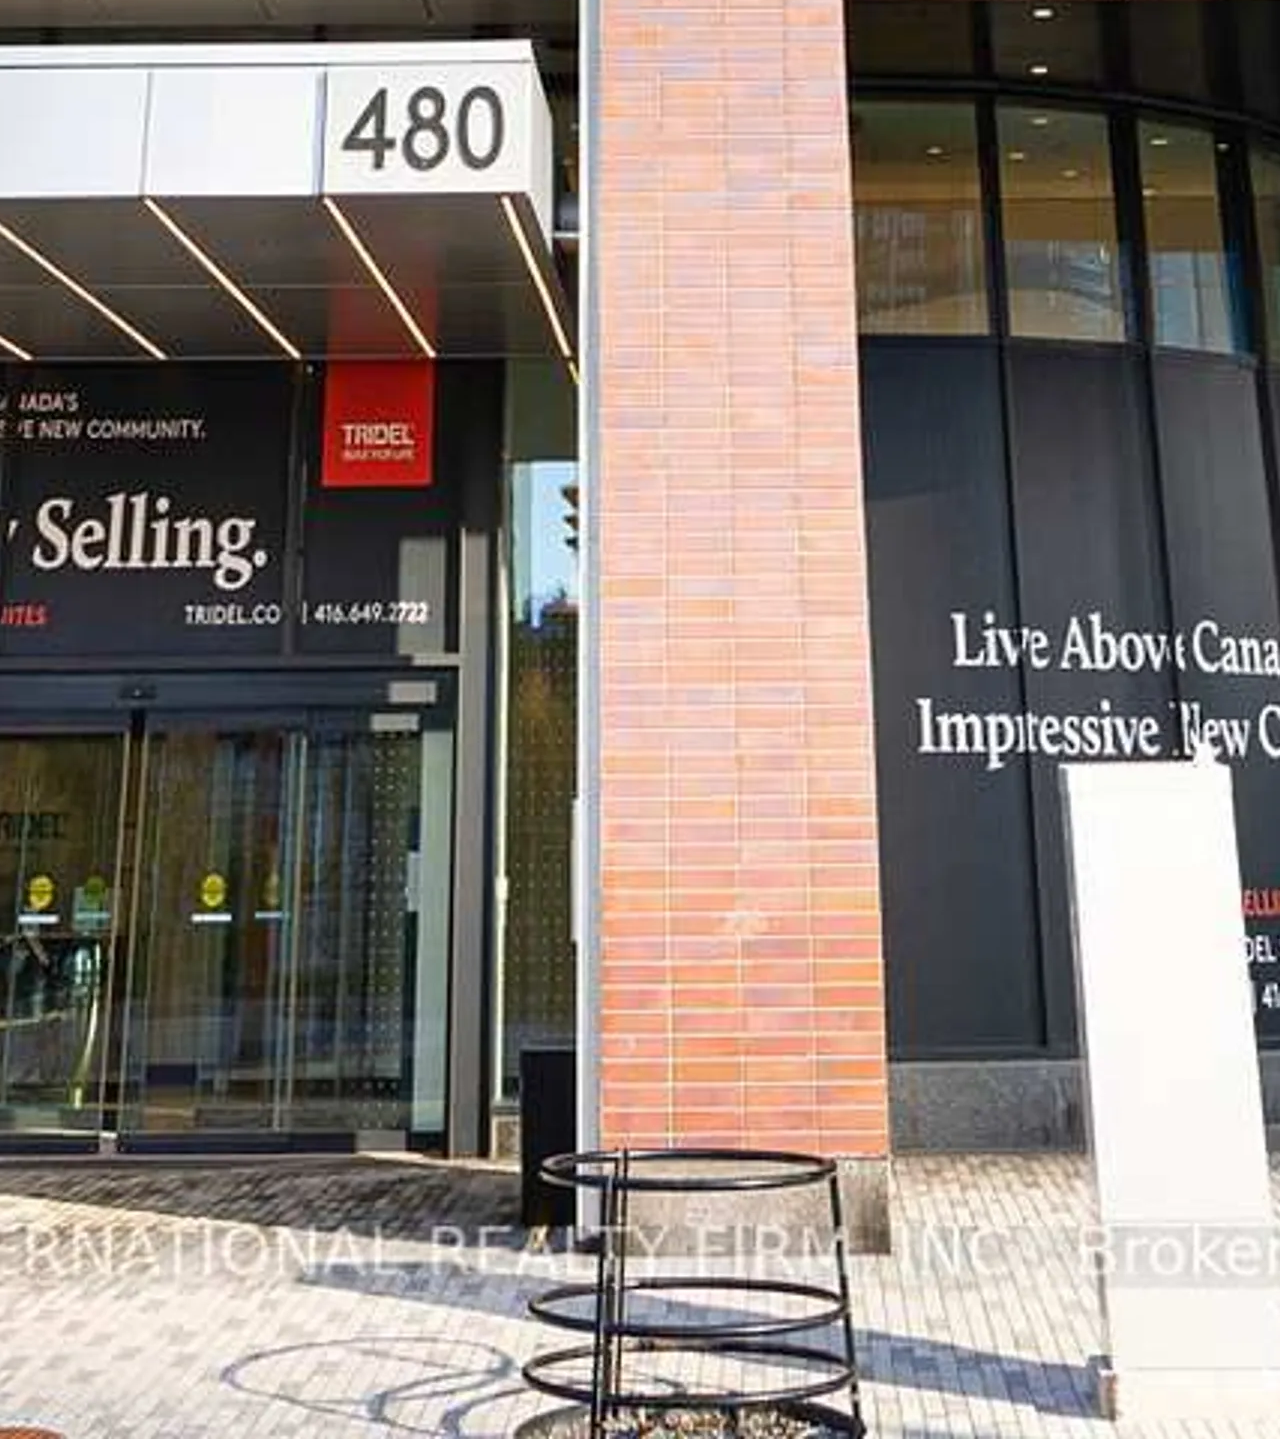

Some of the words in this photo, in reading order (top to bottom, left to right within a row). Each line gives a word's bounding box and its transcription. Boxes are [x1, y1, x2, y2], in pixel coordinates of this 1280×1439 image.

[342, 86, 504, 171] 480
[38, 419, 83, 439] NEW
[86, 419, 207, 440] COMMUNITY.
[341, 423, 415, 445] TRIDEL
[32, 492, 267, 590] Selling.
[184, 604, 281, 625] TRIDEL.CO
[950, 610, 1050, 668] Live
